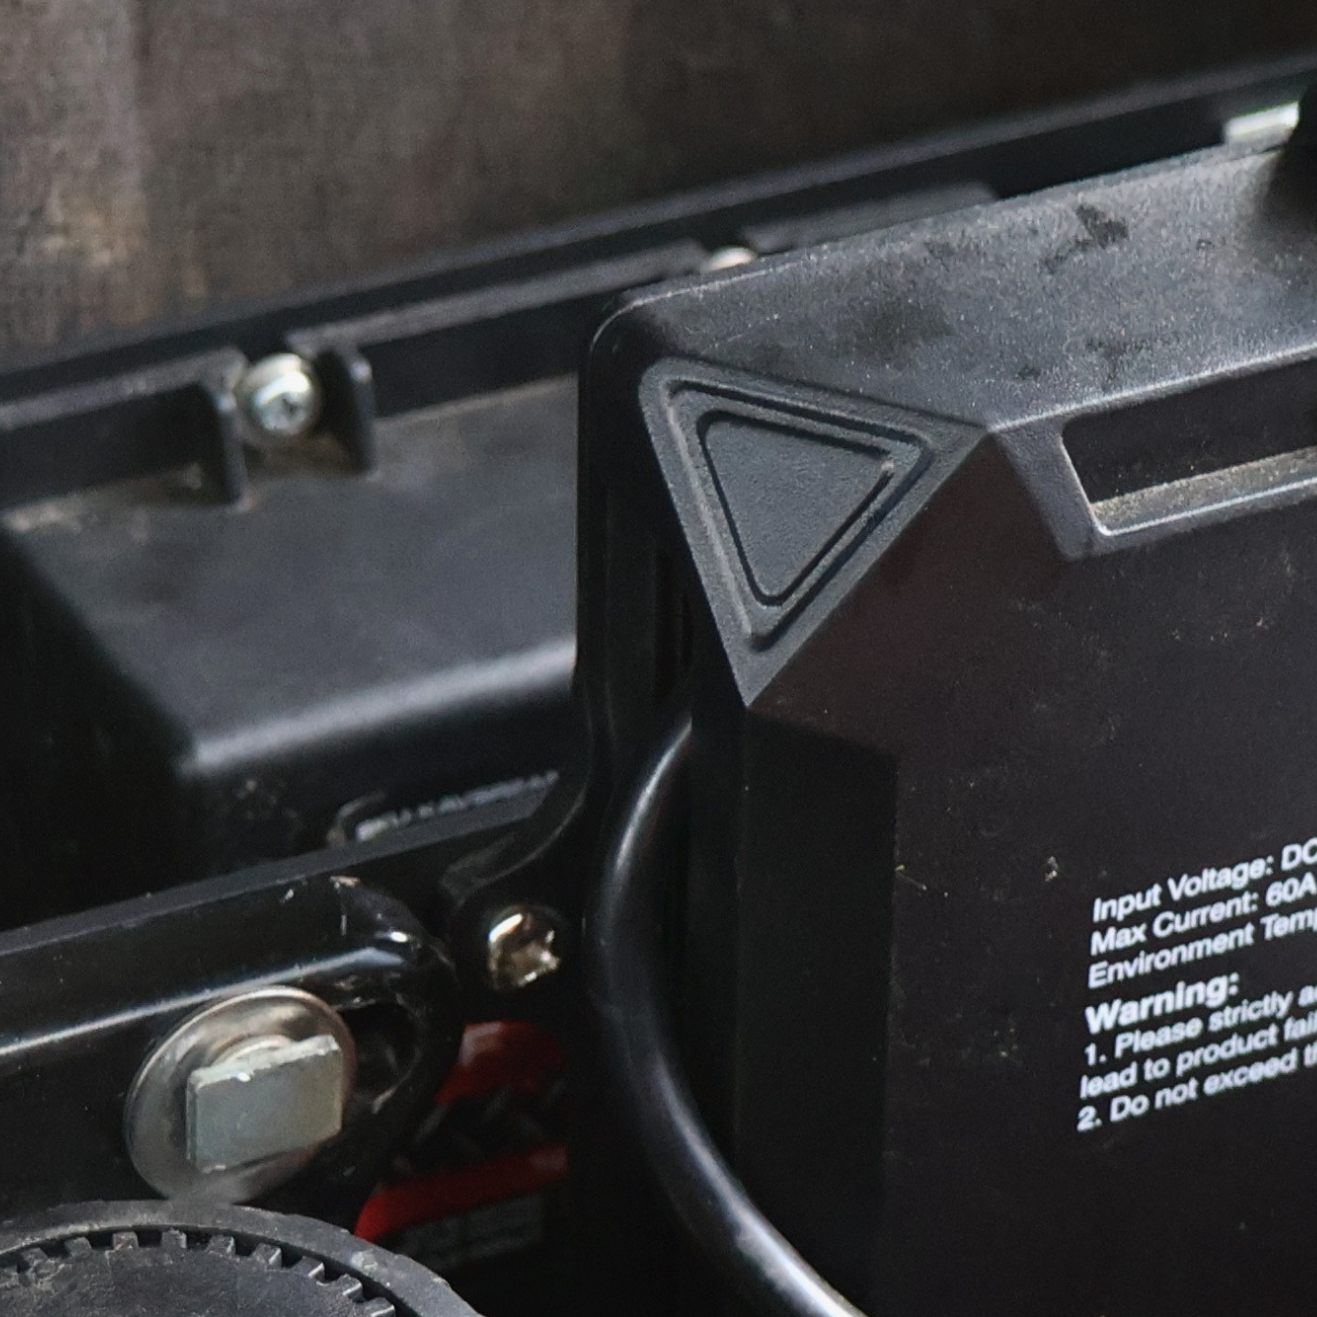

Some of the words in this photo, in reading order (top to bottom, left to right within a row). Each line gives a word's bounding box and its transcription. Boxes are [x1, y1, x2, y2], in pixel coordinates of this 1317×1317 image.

[1089, 921, 1148, 956] Max
[1151, 889, 1260, 938] Current:
[1091, 881, 1163, 923] Input
[1166, 854, 1275, 902] Voltage:
[1087, 921, 1255, 989] Environment
[1083, 971, 1240, 1035] Warning:
[1083, 1041, 1107, 1066] 1.
[1113, 1016, 1204, 1059] Please
[1207, 989, 1294, 1032] strictly
[1075, 1104, 1102, 1132] 2.
[1108, 1093, 1150, 1122] Do
[1153, 1076, 1199, 1109] not
[1202, 1046, 1299, 1095] exceed
[1078, 1060, 1138, 1099] lead
[1142, 1056, 1171, 1081] to
[1174, 1021, 1280, 1077] product
